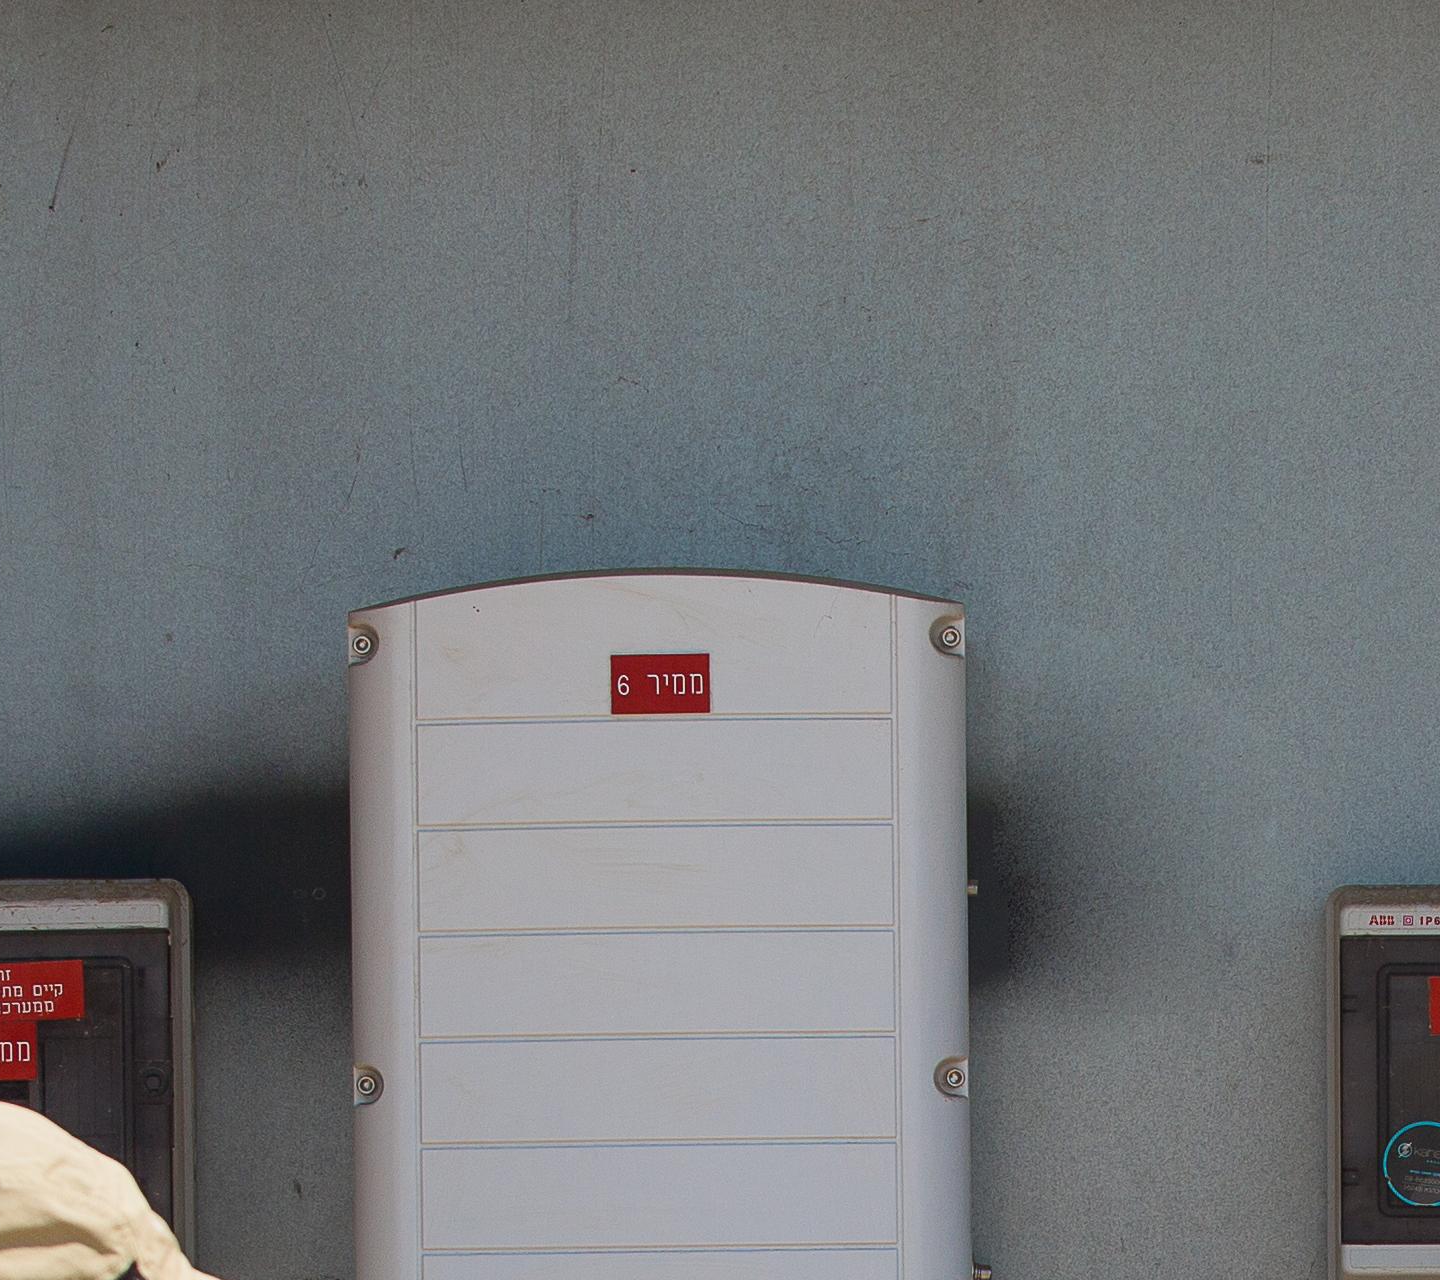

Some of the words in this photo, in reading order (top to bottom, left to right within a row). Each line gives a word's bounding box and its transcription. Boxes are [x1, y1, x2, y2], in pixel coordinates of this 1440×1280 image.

[617, 674, 630, 696] 6
[646, 672, 704, 696] ממיר
[1369, 915, 1395, 926] ABB
[32, 983, 64, 998] קיים
